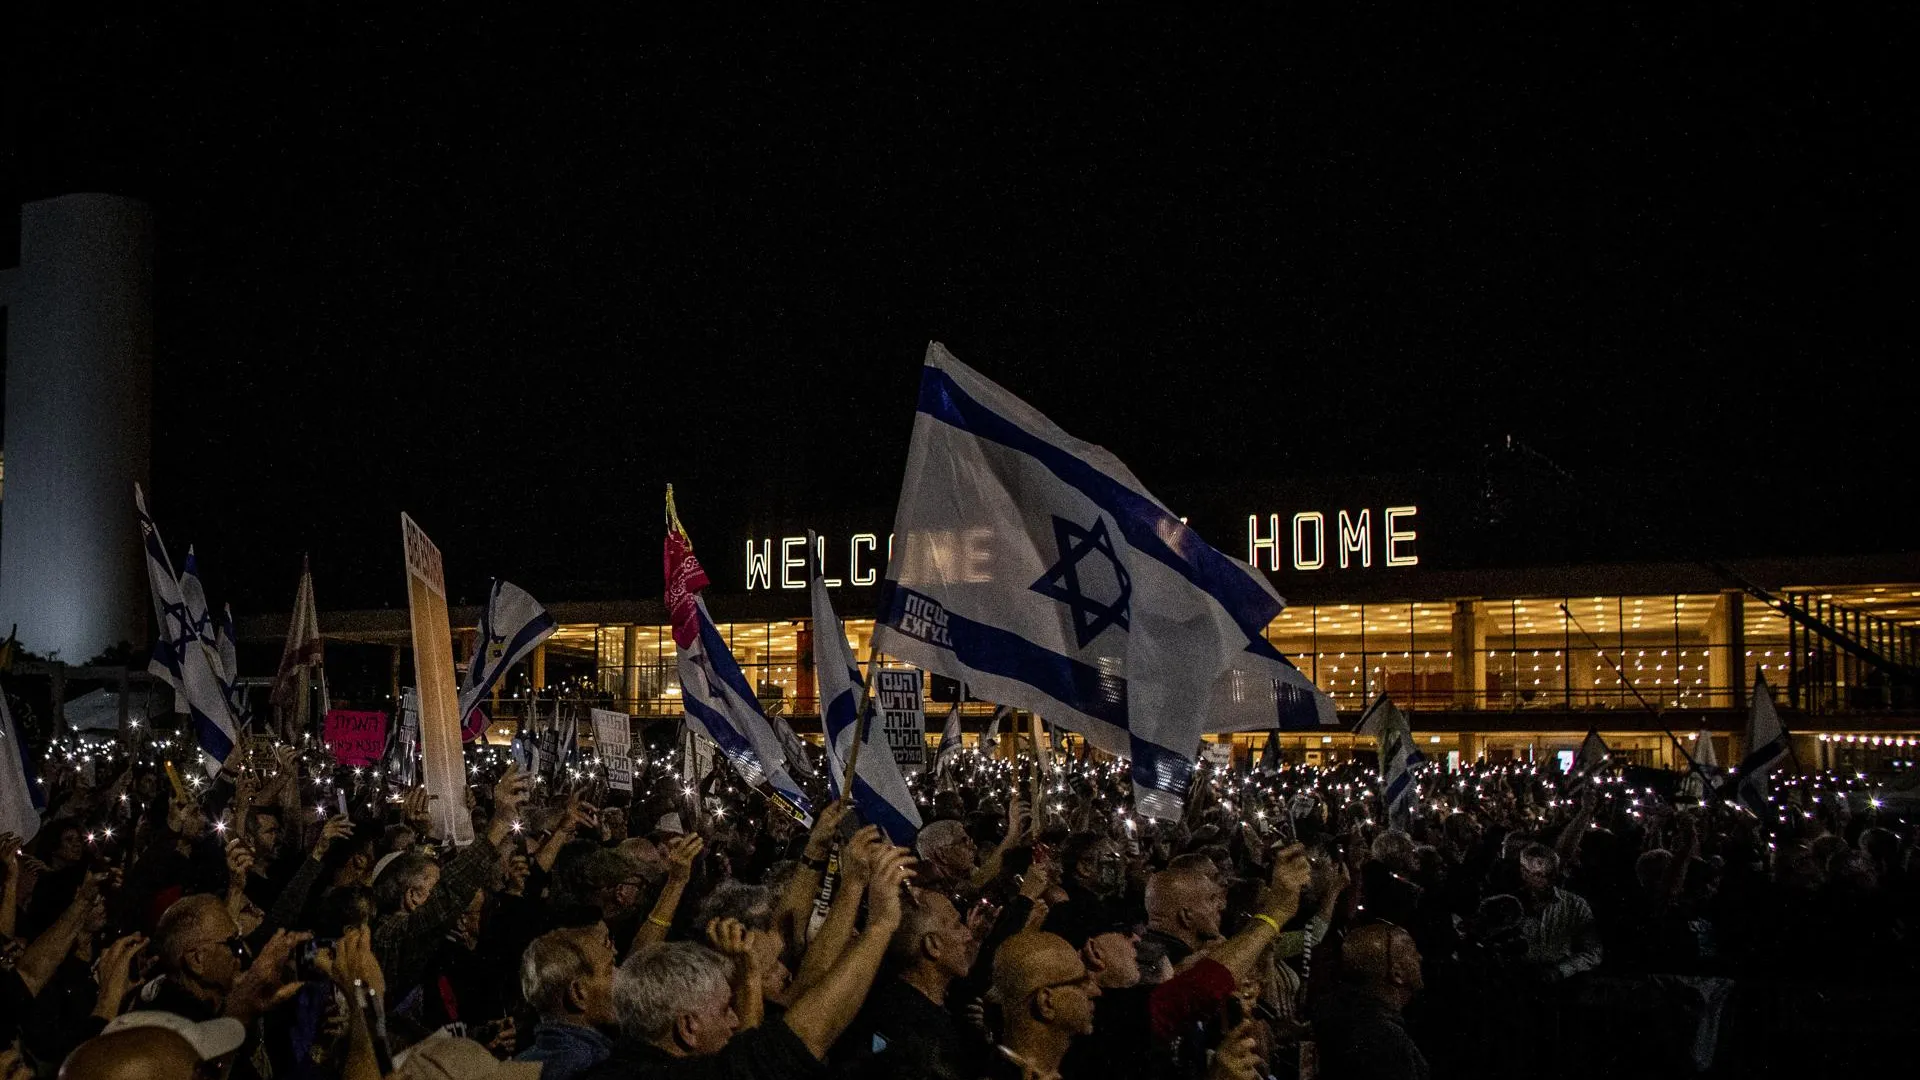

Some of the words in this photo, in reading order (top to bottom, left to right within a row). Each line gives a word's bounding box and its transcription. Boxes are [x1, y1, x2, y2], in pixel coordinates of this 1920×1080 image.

[1248, 506, 1418, 572] HOME
[881, 673, 913, 691] העם
[881, 691, 916, 710] דורש
[885, 711, 916, 728] ועדת
